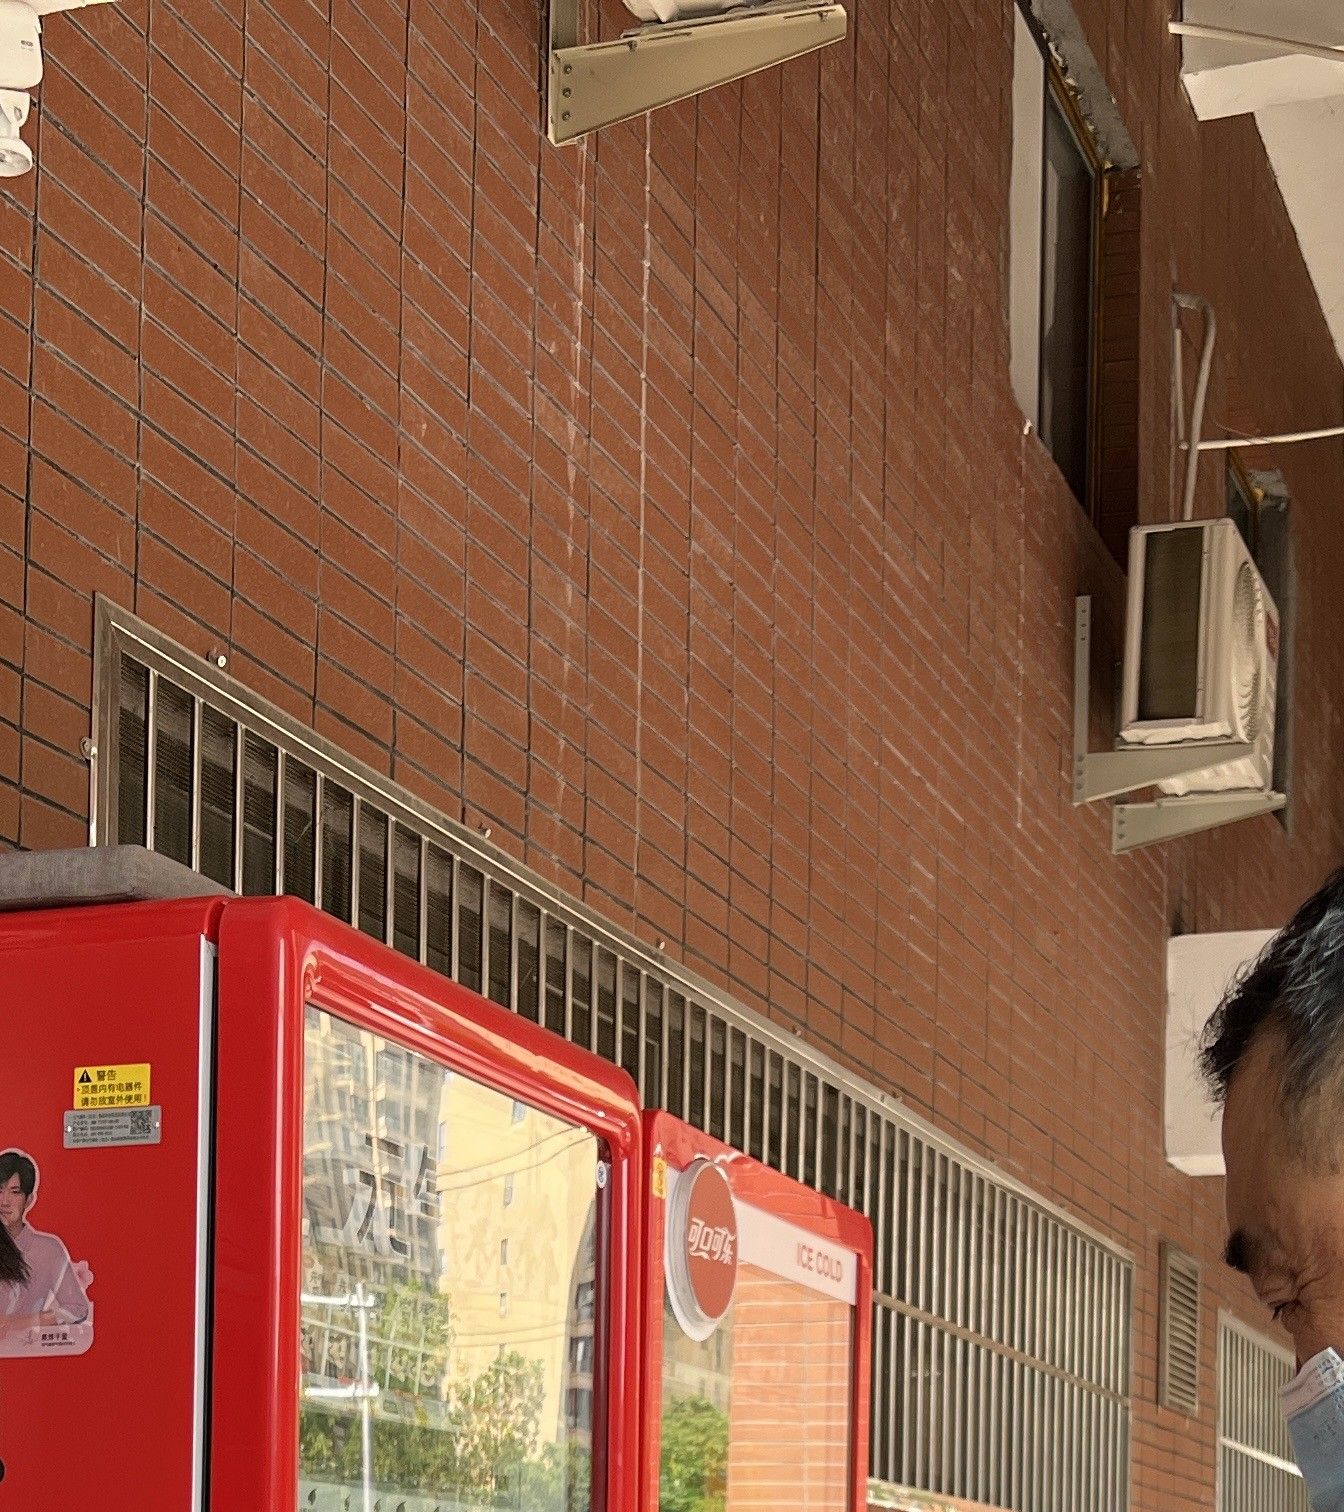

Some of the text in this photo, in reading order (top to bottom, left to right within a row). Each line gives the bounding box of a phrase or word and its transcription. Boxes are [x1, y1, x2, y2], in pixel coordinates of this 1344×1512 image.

[96, 1069, 116, 1081] 警告
[687, 1217, 736, 1265] 可口可乐
[797, 1242, 843, 1282] ICE COLD
